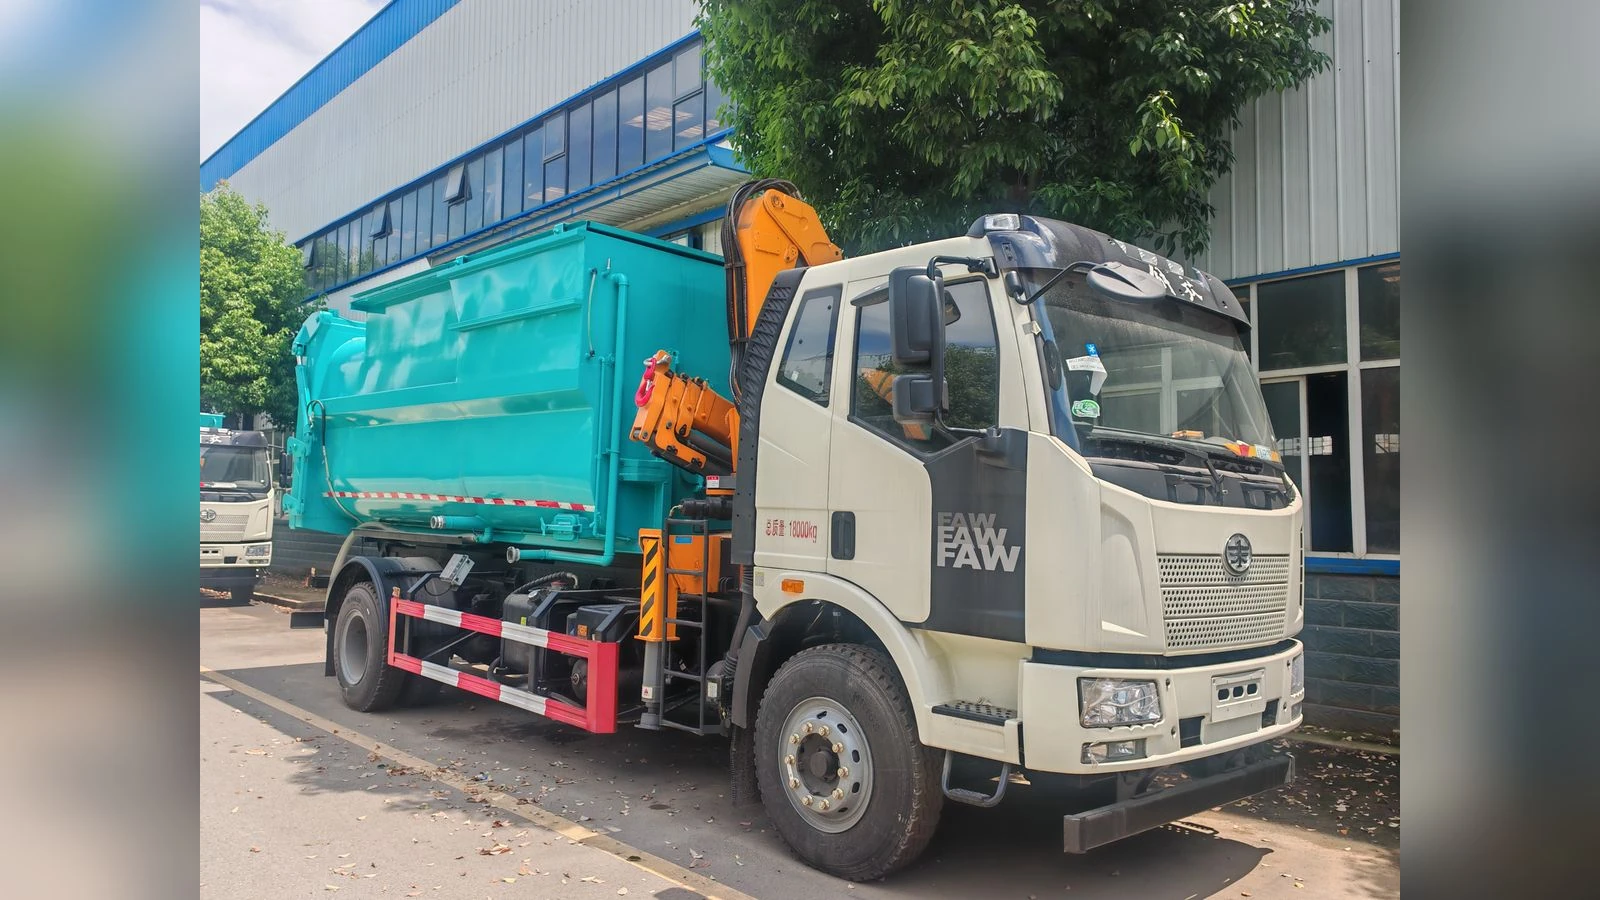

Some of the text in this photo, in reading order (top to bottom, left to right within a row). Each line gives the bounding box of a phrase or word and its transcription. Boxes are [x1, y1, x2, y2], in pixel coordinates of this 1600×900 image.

[789, 520, 818, 544] 18000kg
[938, 512, 997, 531] FAW
[937, 526, 1008, 549] FAW
[937, 542, 1021, 572] FAW
